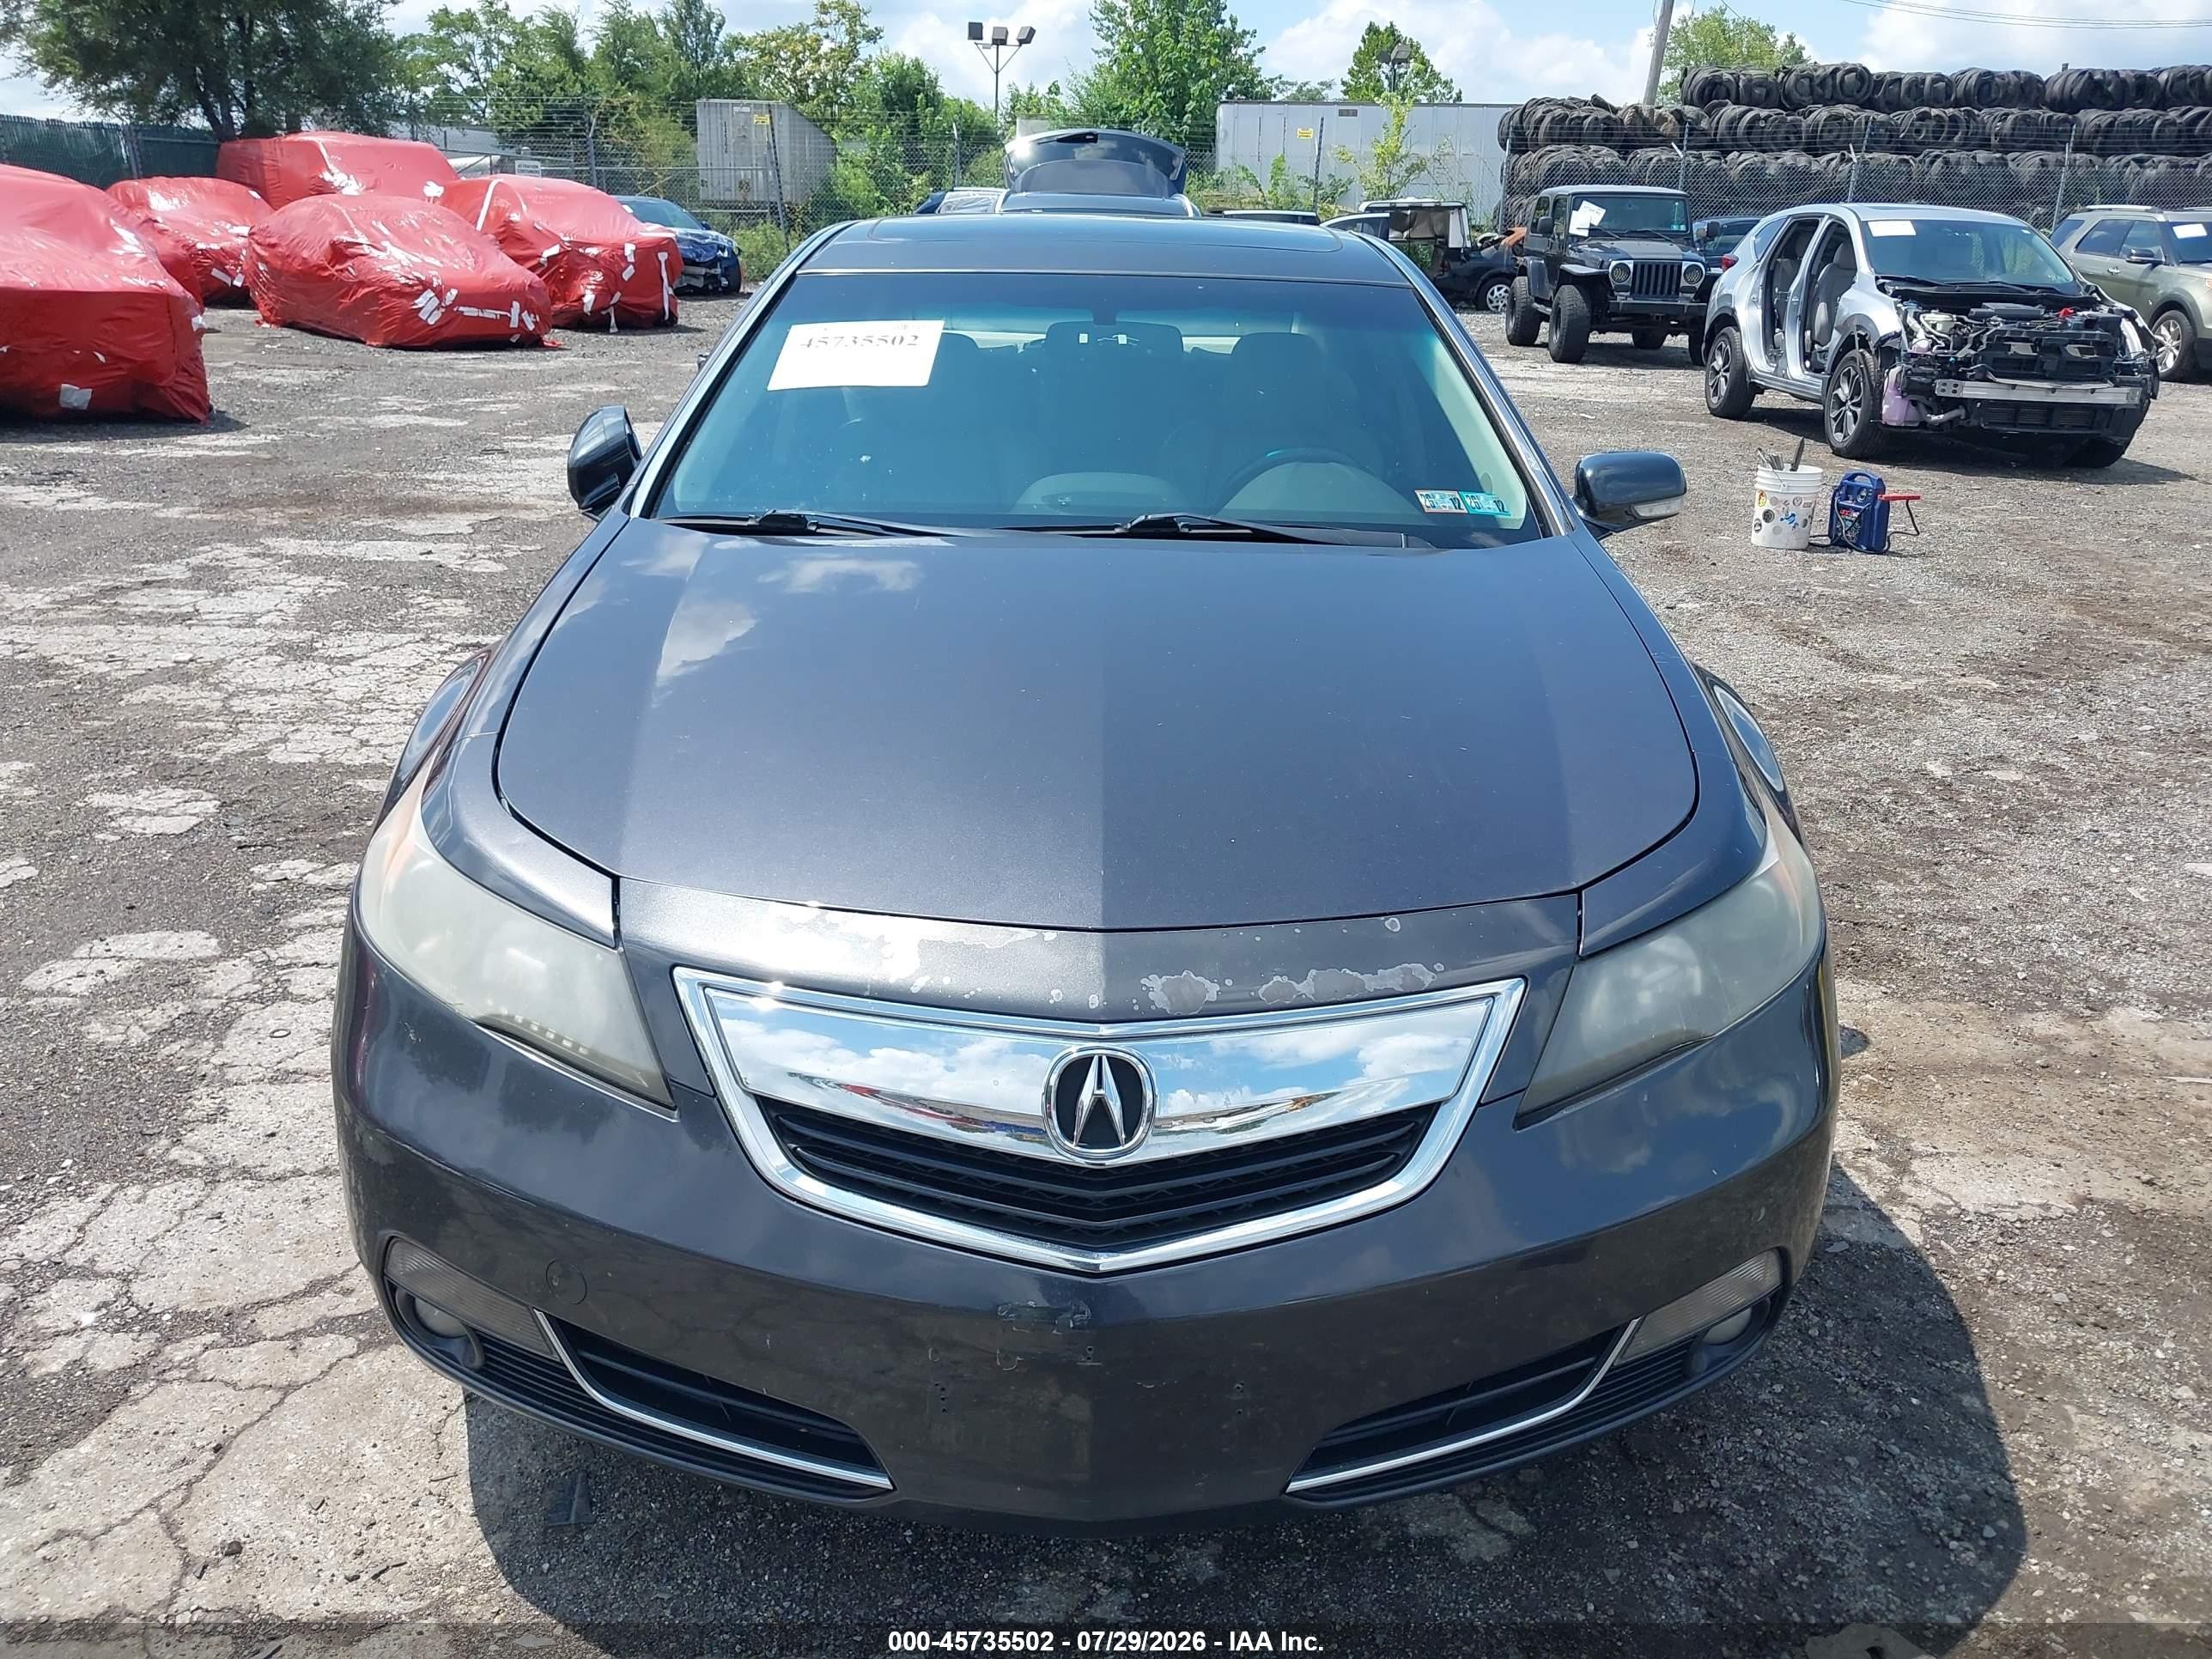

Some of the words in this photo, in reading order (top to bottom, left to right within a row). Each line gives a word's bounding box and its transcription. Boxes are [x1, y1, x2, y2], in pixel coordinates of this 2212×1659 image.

[800, 334, 920, 348] 45735502
[1449, 496, 1465, 510] 12
[1493, 499, 1506, 513] 12
